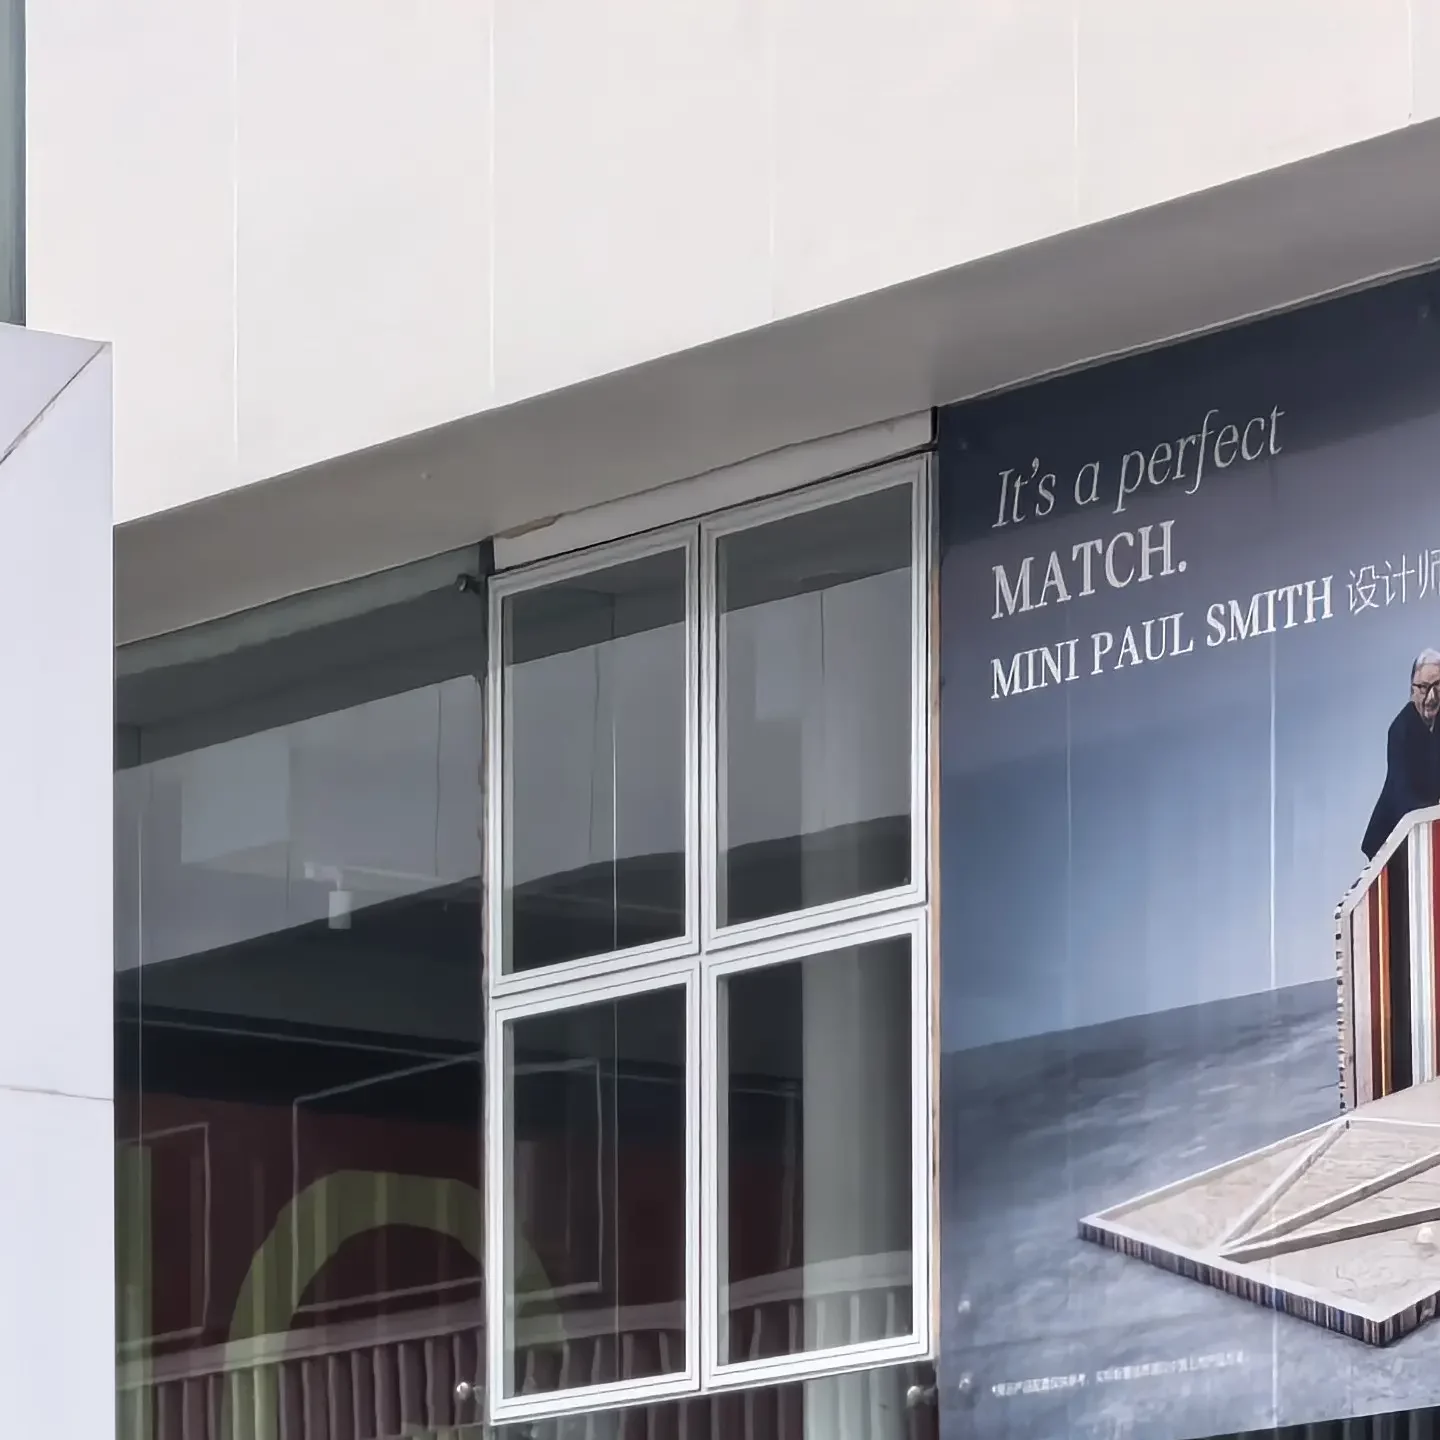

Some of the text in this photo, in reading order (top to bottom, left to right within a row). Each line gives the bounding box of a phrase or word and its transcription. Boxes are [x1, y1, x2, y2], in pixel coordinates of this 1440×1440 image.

[992, 405, 1286, 528] It's a perfect
[991, 519, 1187, 620] MATCH.
[991, 640, 1080, 698] MINI
[1090, 613, 1194, 675] PAUL
[1205, 577, 1334, 648] SMITH
